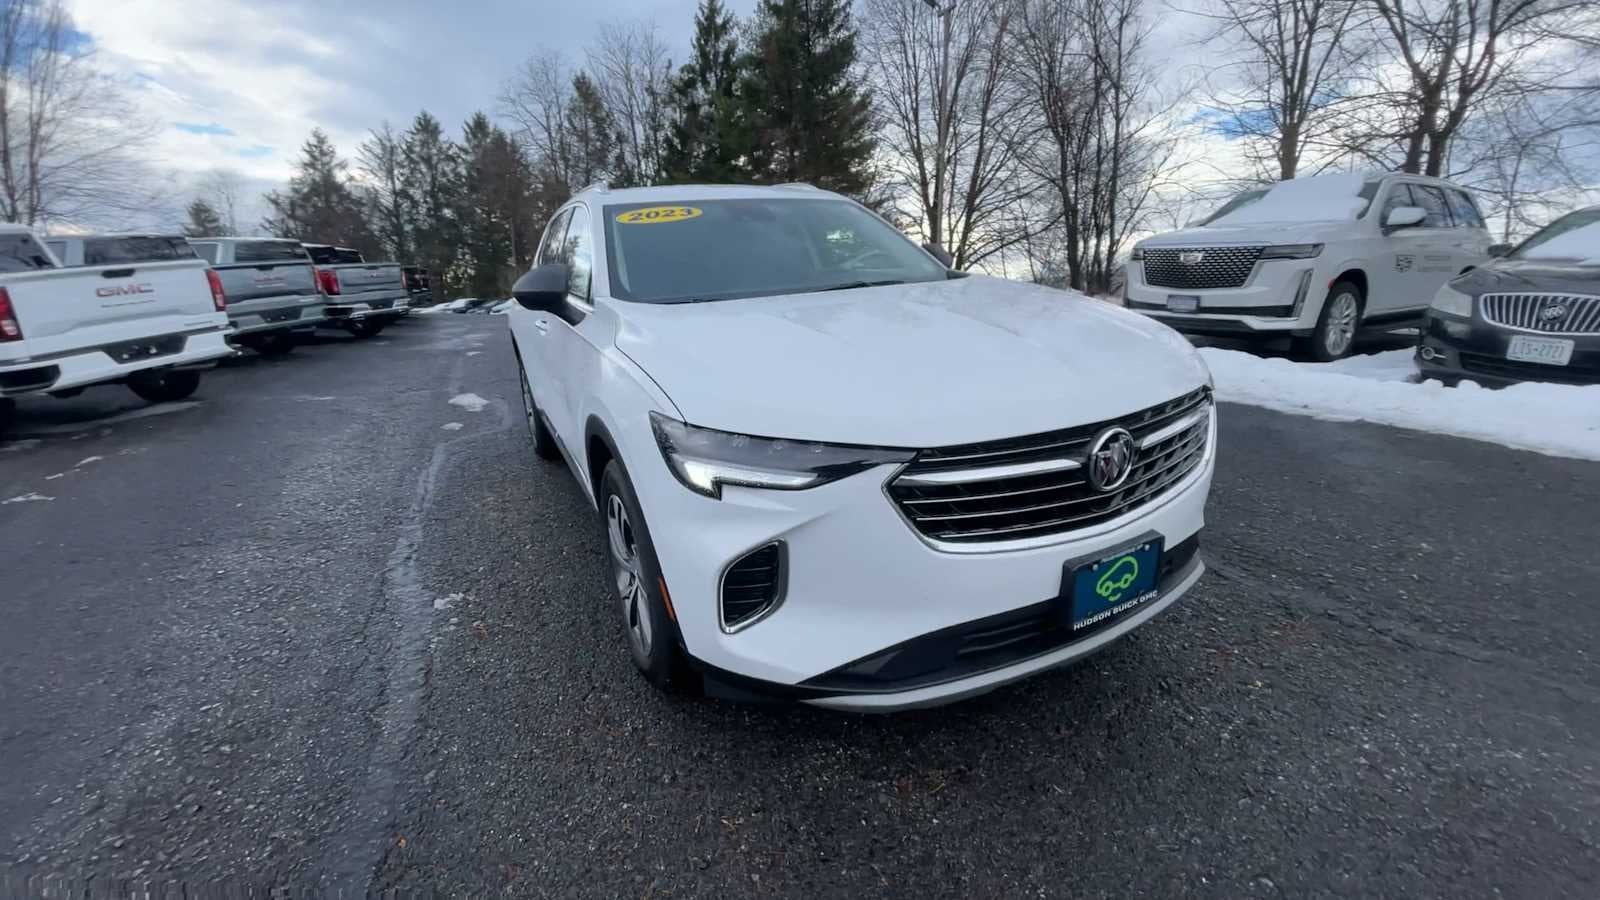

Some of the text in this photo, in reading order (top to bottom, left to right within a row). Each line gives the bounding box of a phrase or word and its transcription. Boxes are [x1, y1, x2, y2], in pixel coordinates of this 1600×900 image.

[628, 208, 693, 221] 2023
[96, 283, 153, 297] GMC
[1073, 590, 1158, 631] HUDSON BUICK GMC
